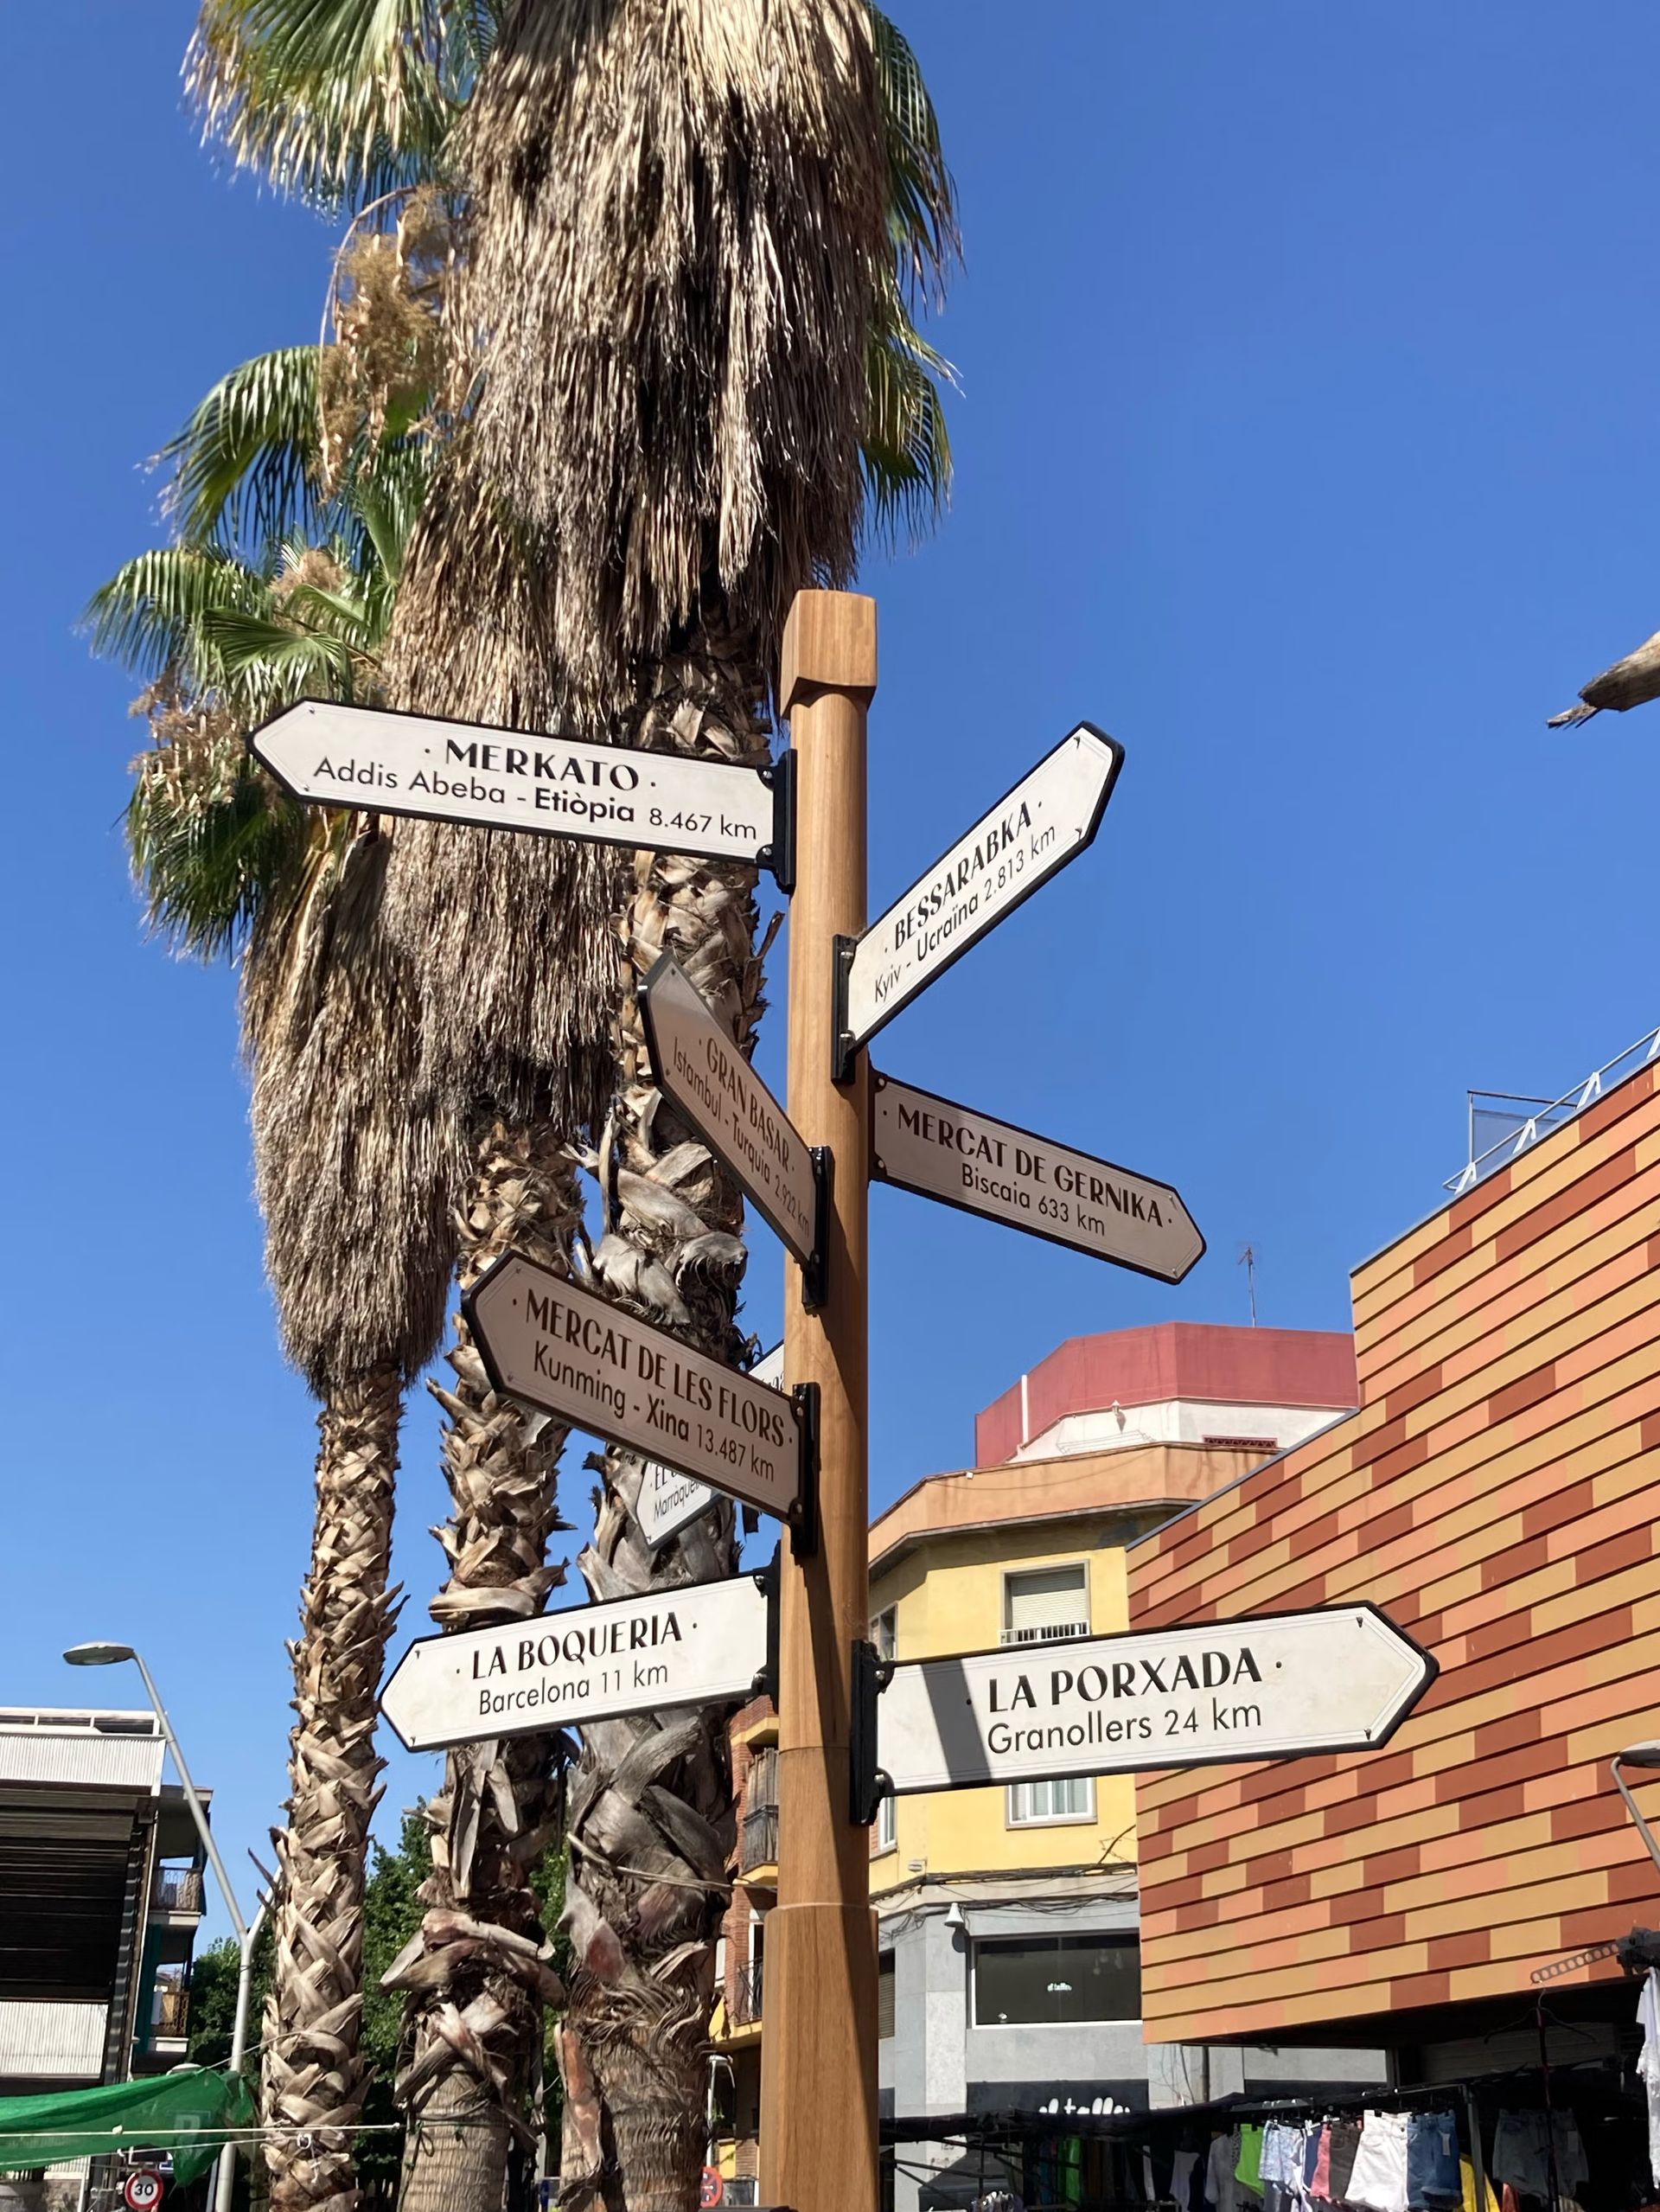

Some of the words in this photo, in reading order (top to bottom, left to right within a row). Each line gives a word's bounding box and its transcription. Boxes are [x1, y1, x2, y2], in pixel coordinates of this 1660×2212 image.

[313, 756, 398, 790] Addis
[408, 770, 505, 804] Abeba
[535, 786, 635, 823] Etiòpia
[649, 808, 712, 834] 8.467
[719, 814, 757, 841] km
[445, 738, 639, 792] MERKATO
[875, 964, 901, 1003] Kyiv
[917, 892, 978, 962] Ucraïna
[985, 849, 1025, 901] 2.813
[1031, 825, 1056, 860] km
[895, 801, 1031, 950] BESSARABKA
[673, 1037, 722, 1122] Istambul
[732, 1112, 770, 1185] Turquia
[797, 1204, 810, 1237] km
[706, 1038, 746, 1114] GRAN
[750, 1093, 789, 1171] BASAR
[898, 1103, 1007, 1167] MERCAT
[1016, 1148, 1047, 1183] DE
[1054, 1164, 1163, 1228] GERNIKA
[961, 1163, 1030, 1209] Biscaia
[1038, 1195, 1069, 1223] 633
[1077, 1205, 1105, 1236] km
[526, 1288, 632, 1370] MERCAT
[639, 1343, 667, 1390] DE
[674, 1363, 712, 1412] LES
[718, 1385, 784, 1447] FLORS
[533, 1340, 626, 1419] Kunming
[646, 1393, 689, 1442] Xina
[696, 1423, 746, 1467] 13.487
[750, 1446, 775, 1482] km
[473, 1646, 507, 1679] LA
[518, 1611, 683, 1672] BOQUERIA
[479, 1678, 590, 1716] Barcelona
[601, 1670, 621, 1694] 11
[634, 1659, 667, 1688] km
[989, 1675, 1037, 1713] LA
[1050, 1646, 1262, 1705] PORXADA
[987, 1710, 1152, 1755] Granollers
[1164, 1706, 1199, 1736] 24
[1213, 1697, 1261, 1731] km
[134, 2183, 154, 2196] 30
